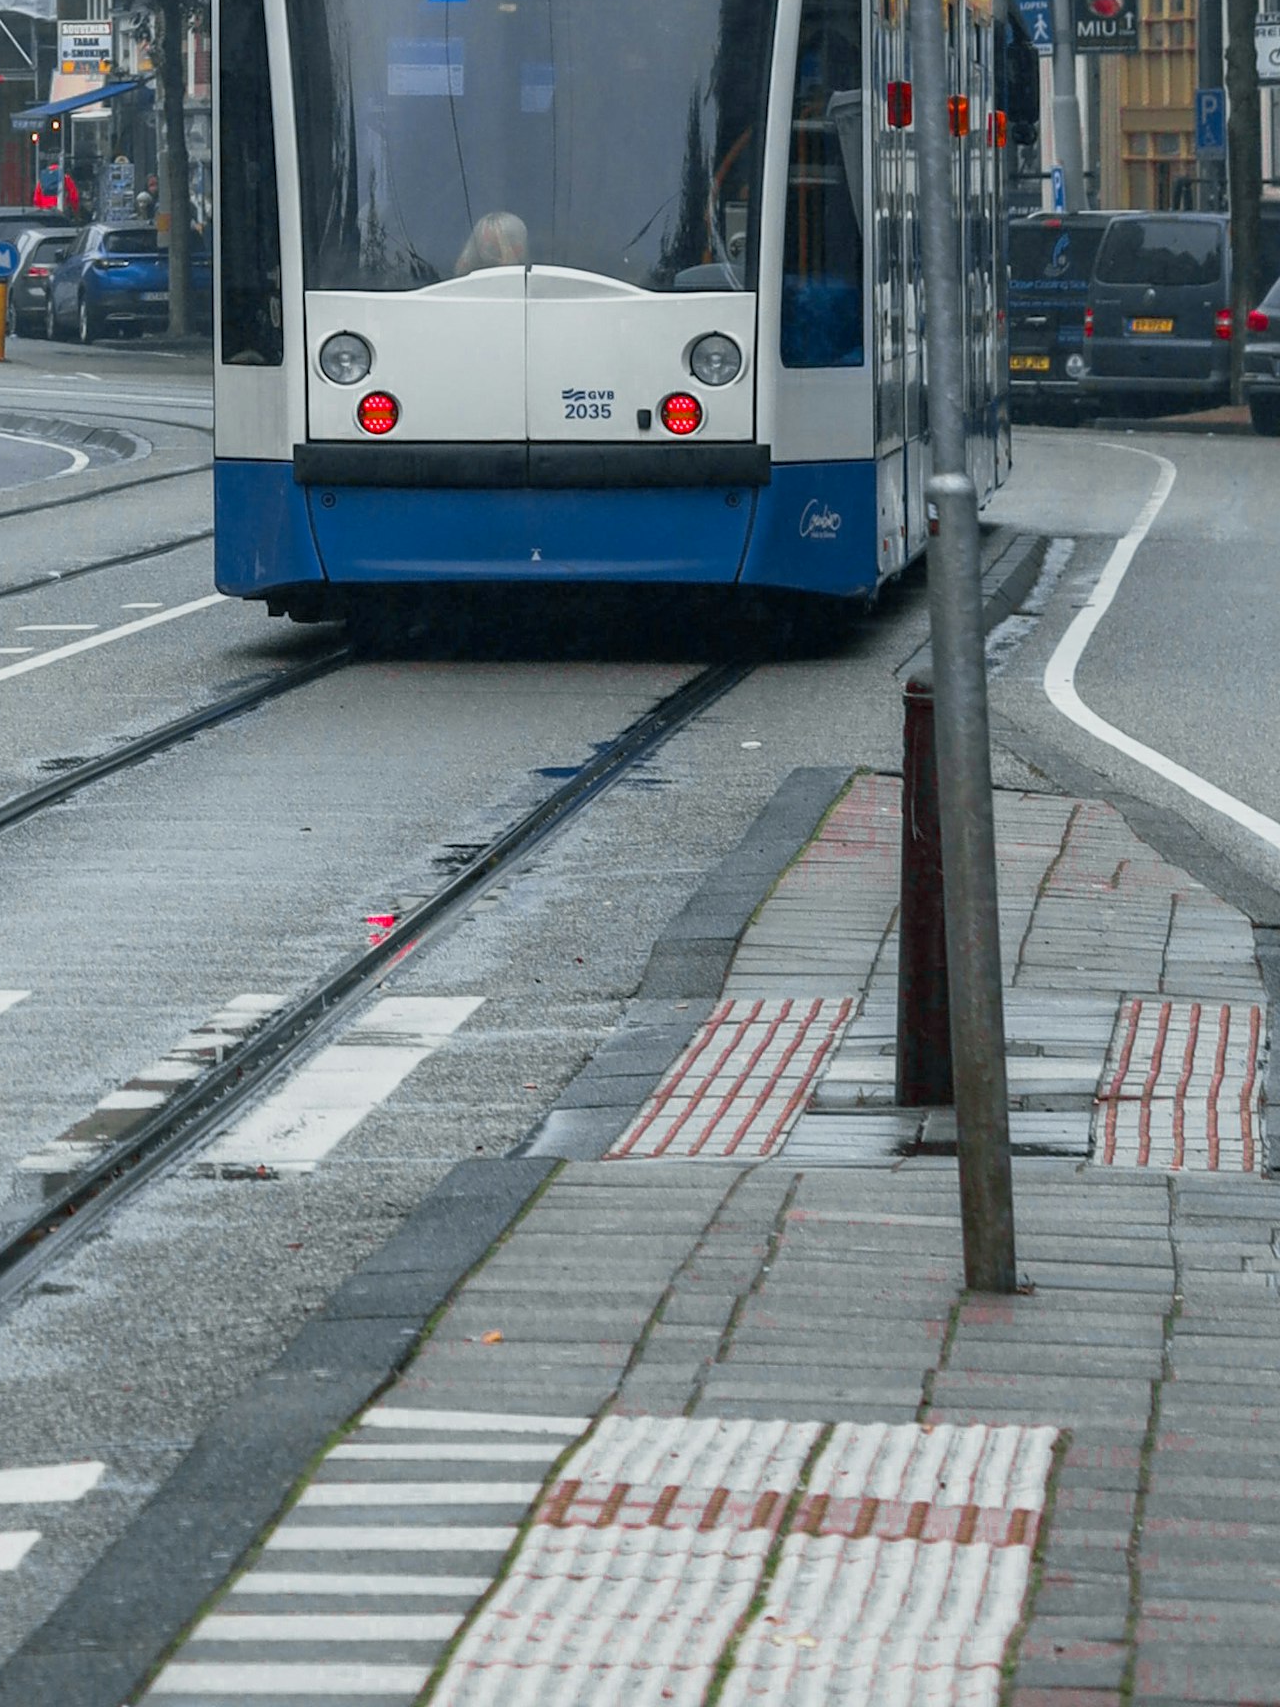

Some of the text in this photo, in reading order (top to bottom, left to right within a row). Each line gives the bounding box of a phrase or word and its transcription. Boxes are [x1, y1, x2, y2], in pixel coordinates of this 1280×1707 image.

[1077, 20, 1117, 37] MIU
[1201, 95, 1218, 124] P
[588, 390, 614, 400] GVB
[565, 404, 611, 419] 2035
